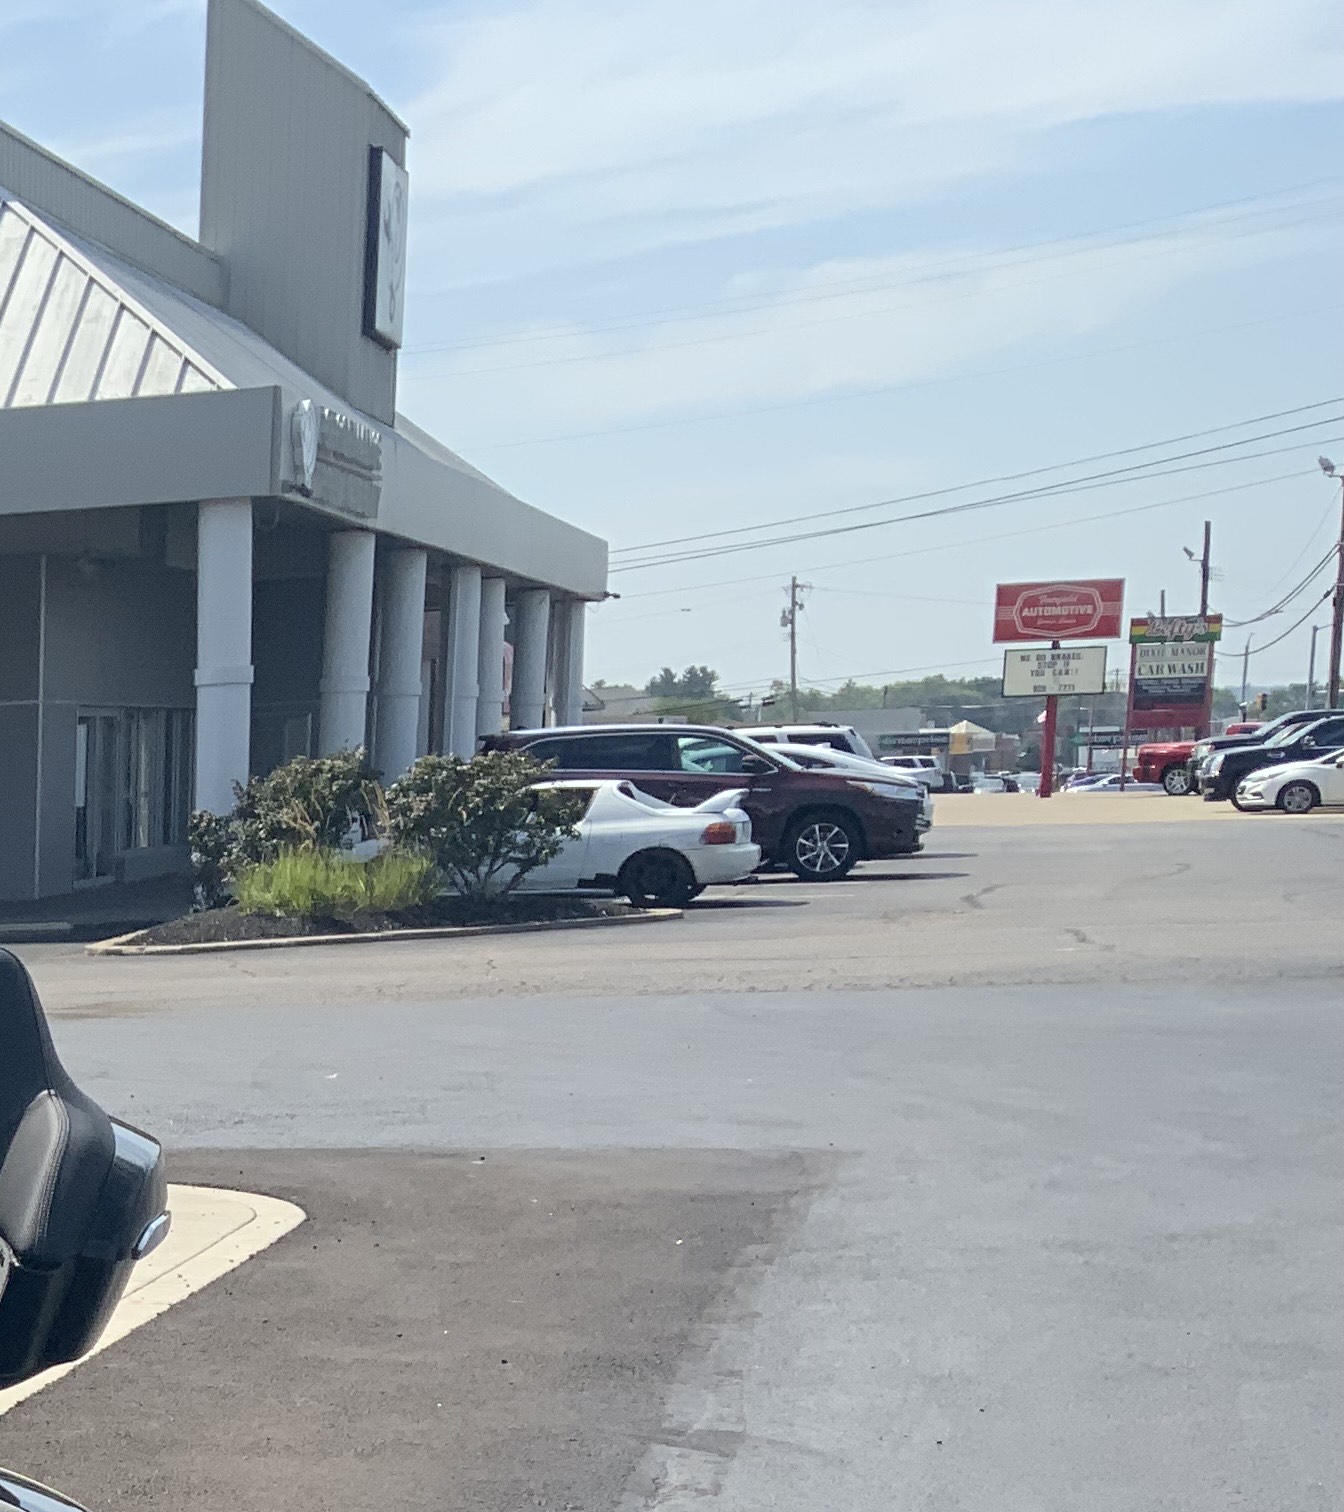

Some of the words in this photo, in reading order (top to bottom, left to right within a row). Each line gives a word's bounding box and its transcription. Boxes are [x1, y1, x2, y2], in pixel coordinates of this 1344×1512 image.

[1021, 604, 1093, 617] AUTOMOTIVE
[1137, 663, 1165, 676] CAR
[1167, 662, 1205, 675] WASH
